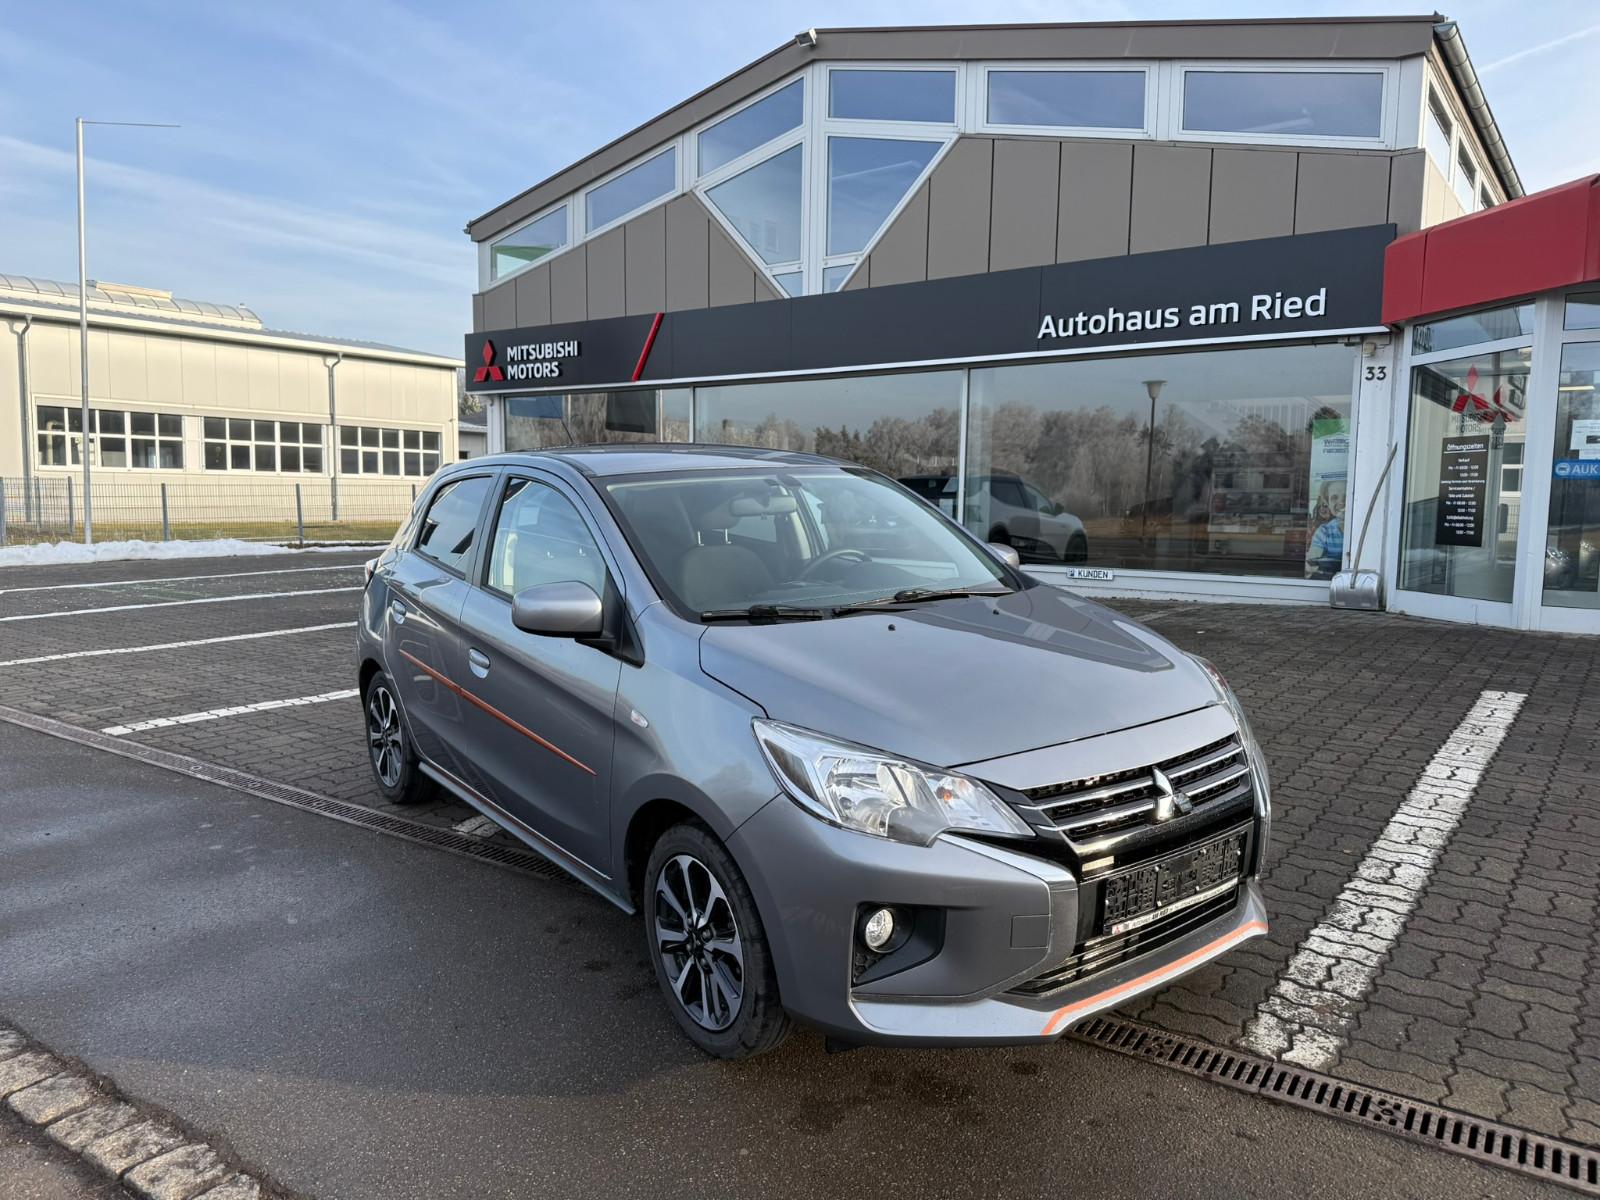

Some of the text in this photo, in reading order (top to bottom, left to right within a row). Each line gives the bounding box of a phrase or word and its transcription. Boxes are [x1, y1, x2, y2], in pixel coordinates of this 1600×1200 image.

[1037, 287, 1327, 339] Autohaus am Ried
[507, 340, 578, 362] MITSUBISHI
[507, 362, 560, 380] MOTORS
[1365, 366, 1387, 381] 33
[1077, 569, 1109, 579] KUNDEN
